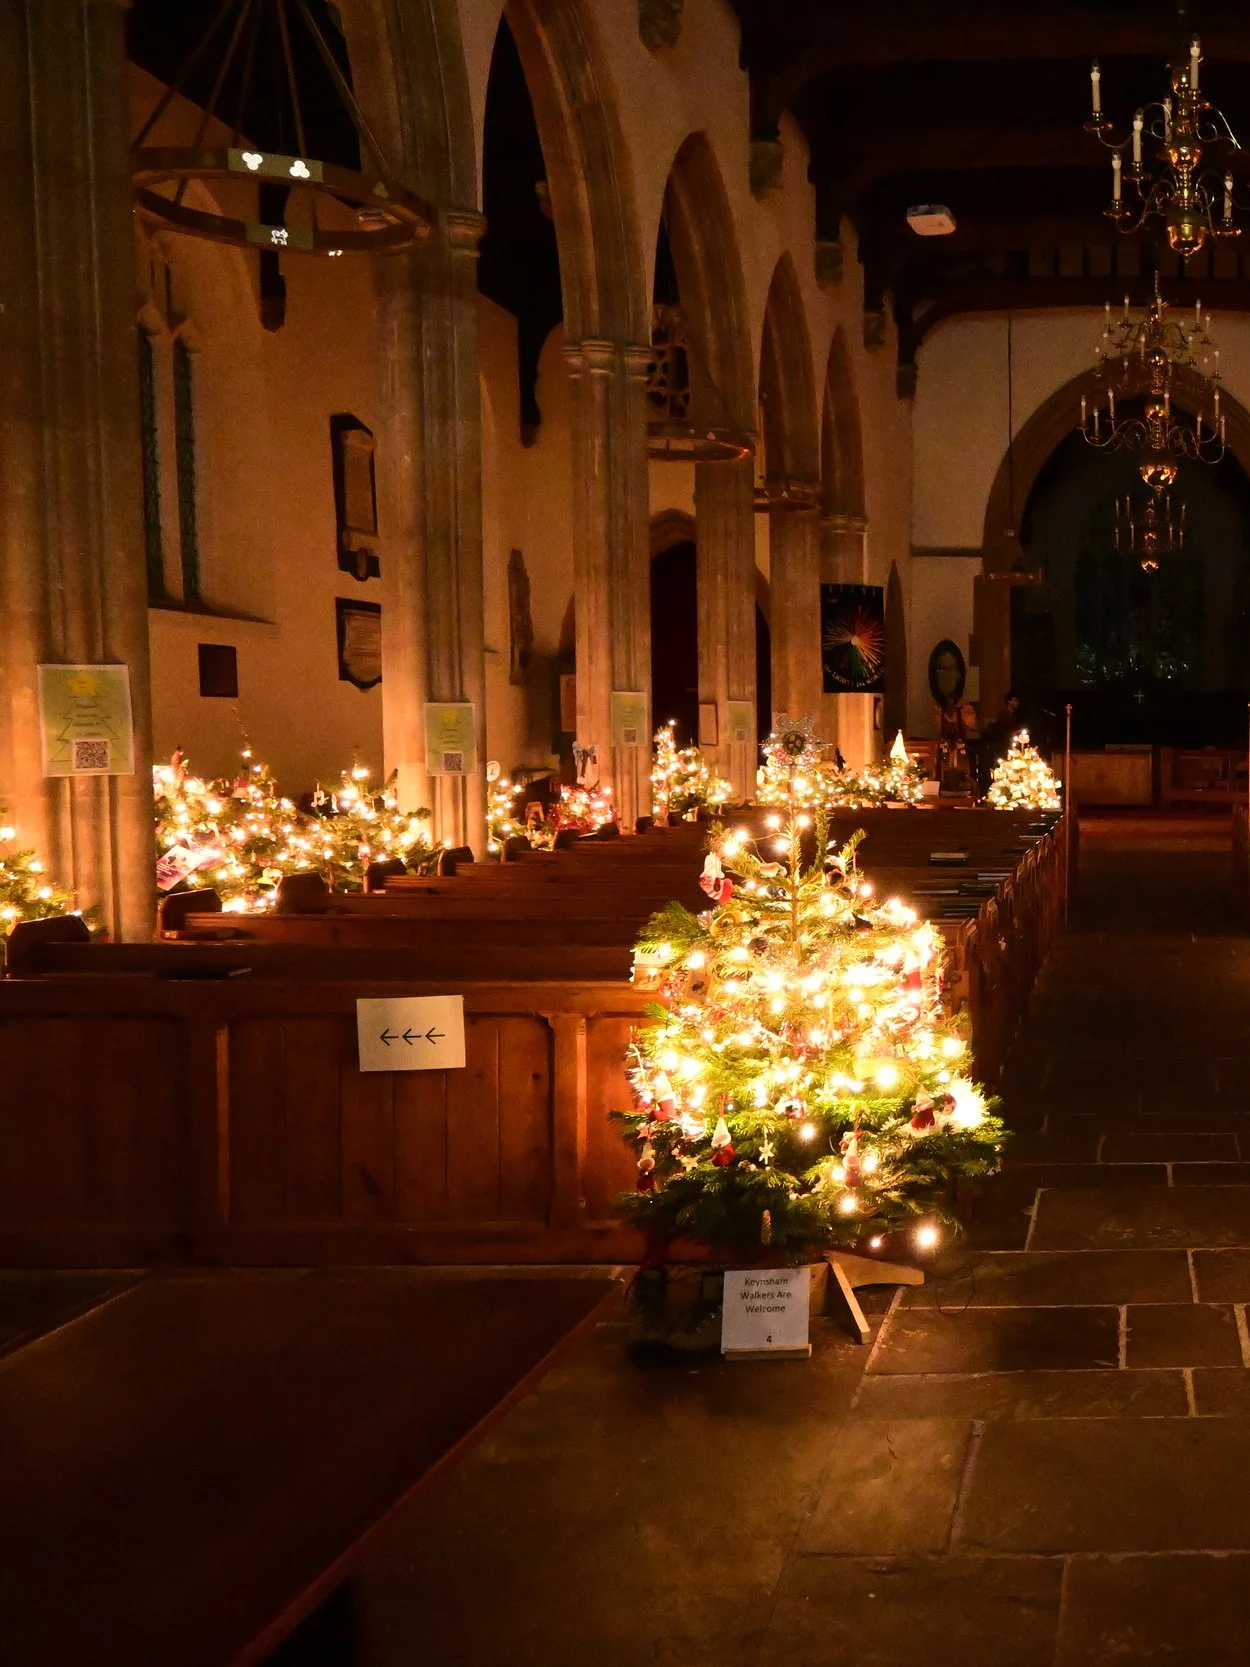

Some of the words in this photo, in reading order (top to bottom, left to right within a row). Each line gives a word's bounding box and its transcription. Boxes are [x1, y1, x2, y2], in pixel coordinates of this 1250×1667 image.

[744, 1278, 789, 1287] Keynsham
[740, 1291, 775, 1300] Walkers
[776, 1290, 792, 1300] Are
[745, 1305, 786, 1313] Welcome
[766, 1335, 772, 1343] 4
